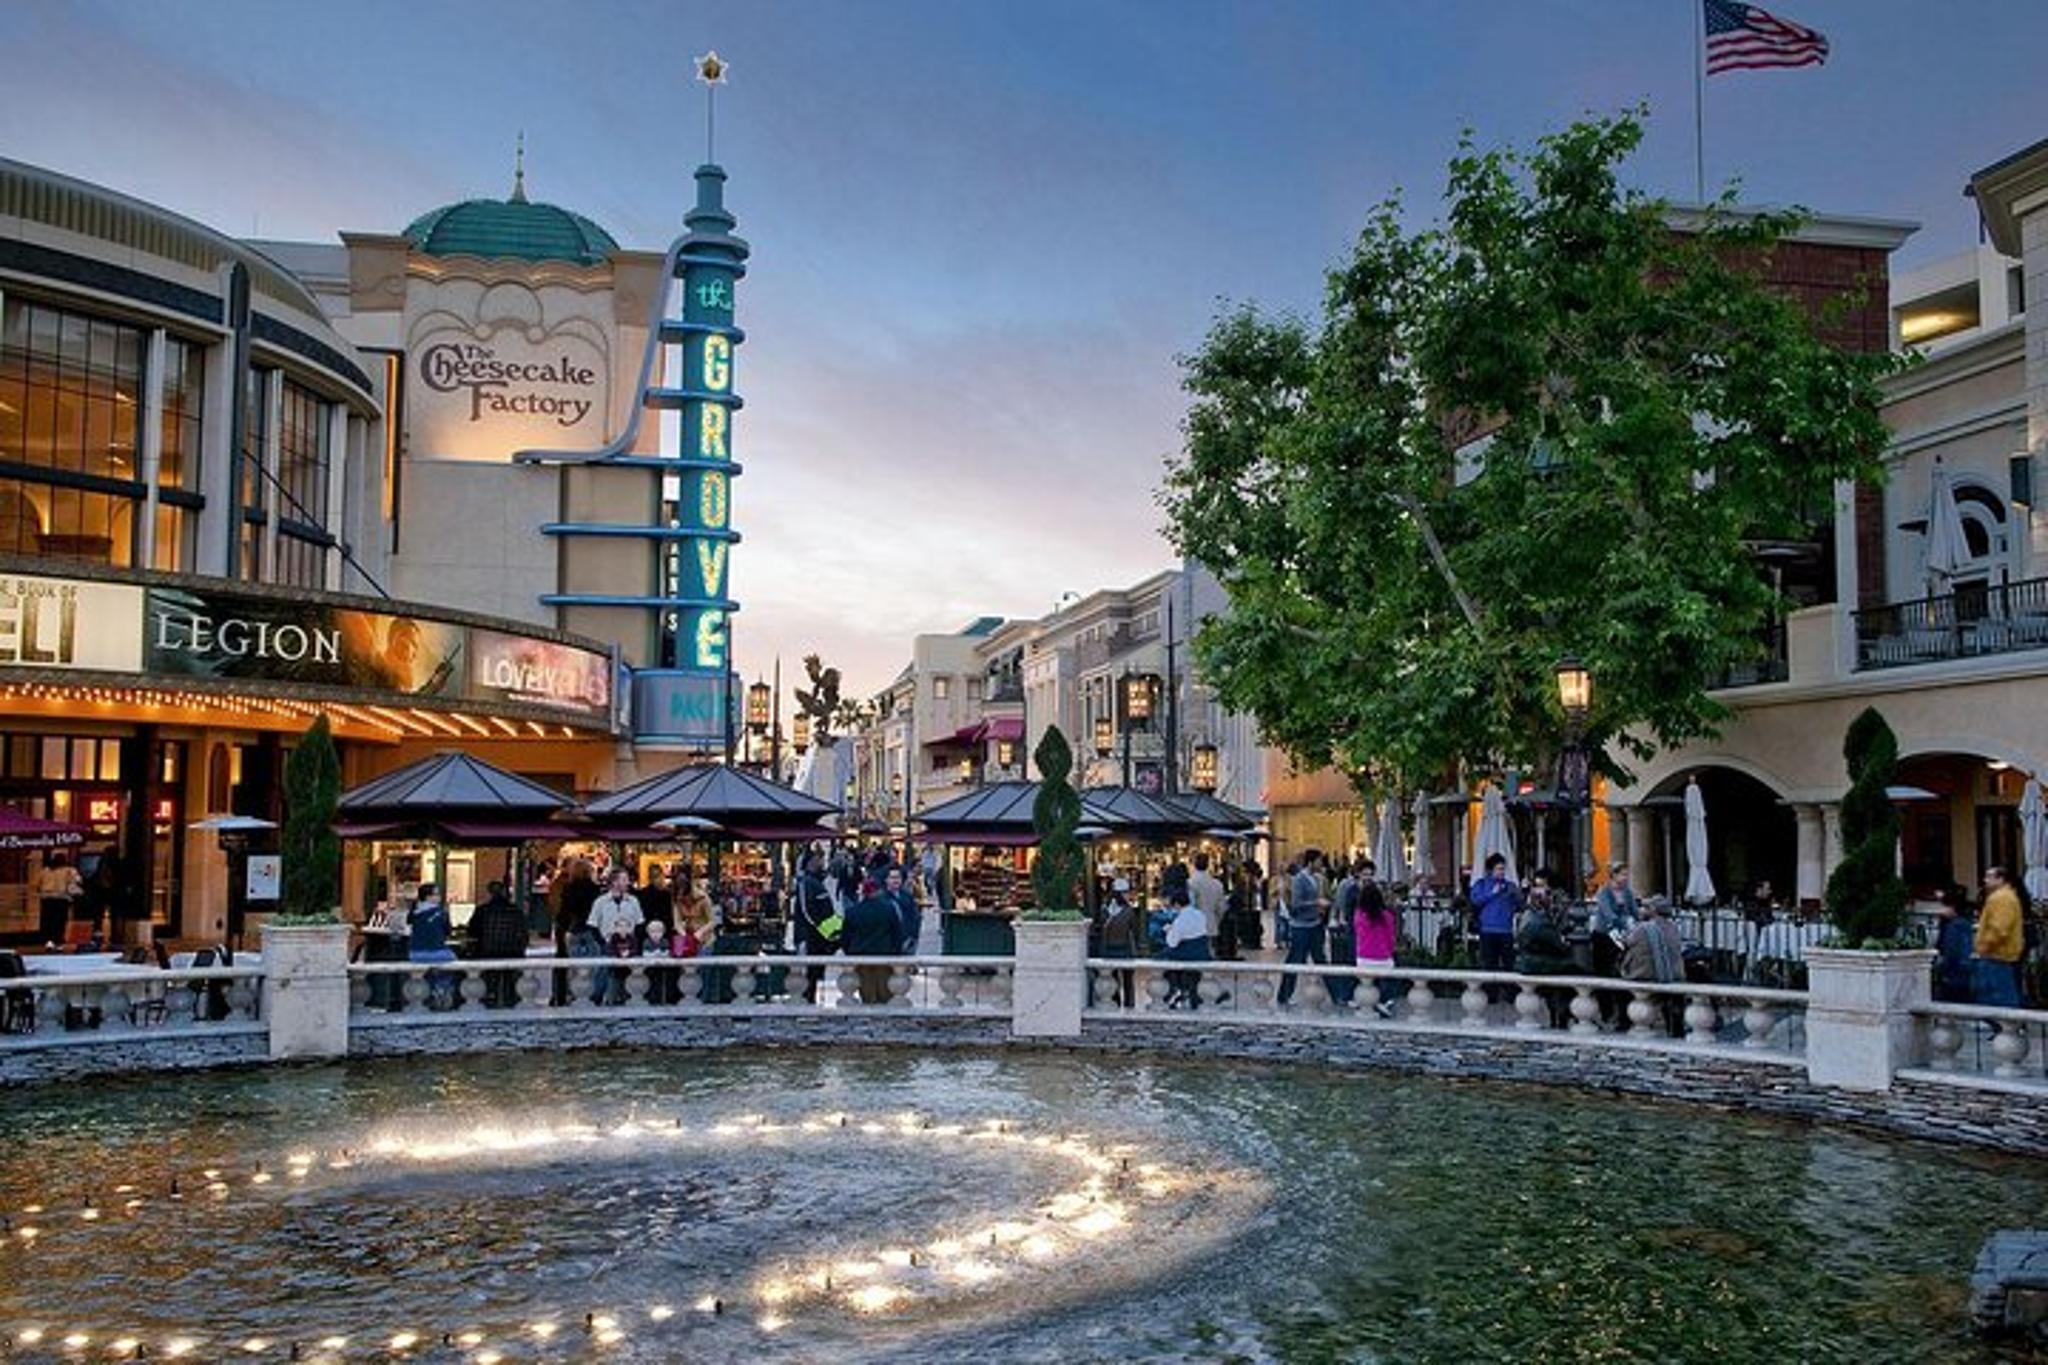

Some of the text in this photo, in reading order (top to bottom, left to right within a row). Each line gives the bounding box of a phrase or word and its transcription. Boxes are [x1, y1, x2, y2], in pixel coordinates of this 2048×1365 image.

[420, 343, 595, 393] Cheesecake
[457, 380, 593, 427] Factory
[697, 334, 730, 667] GROVE
[155, 611, 342, 664] LEGION
